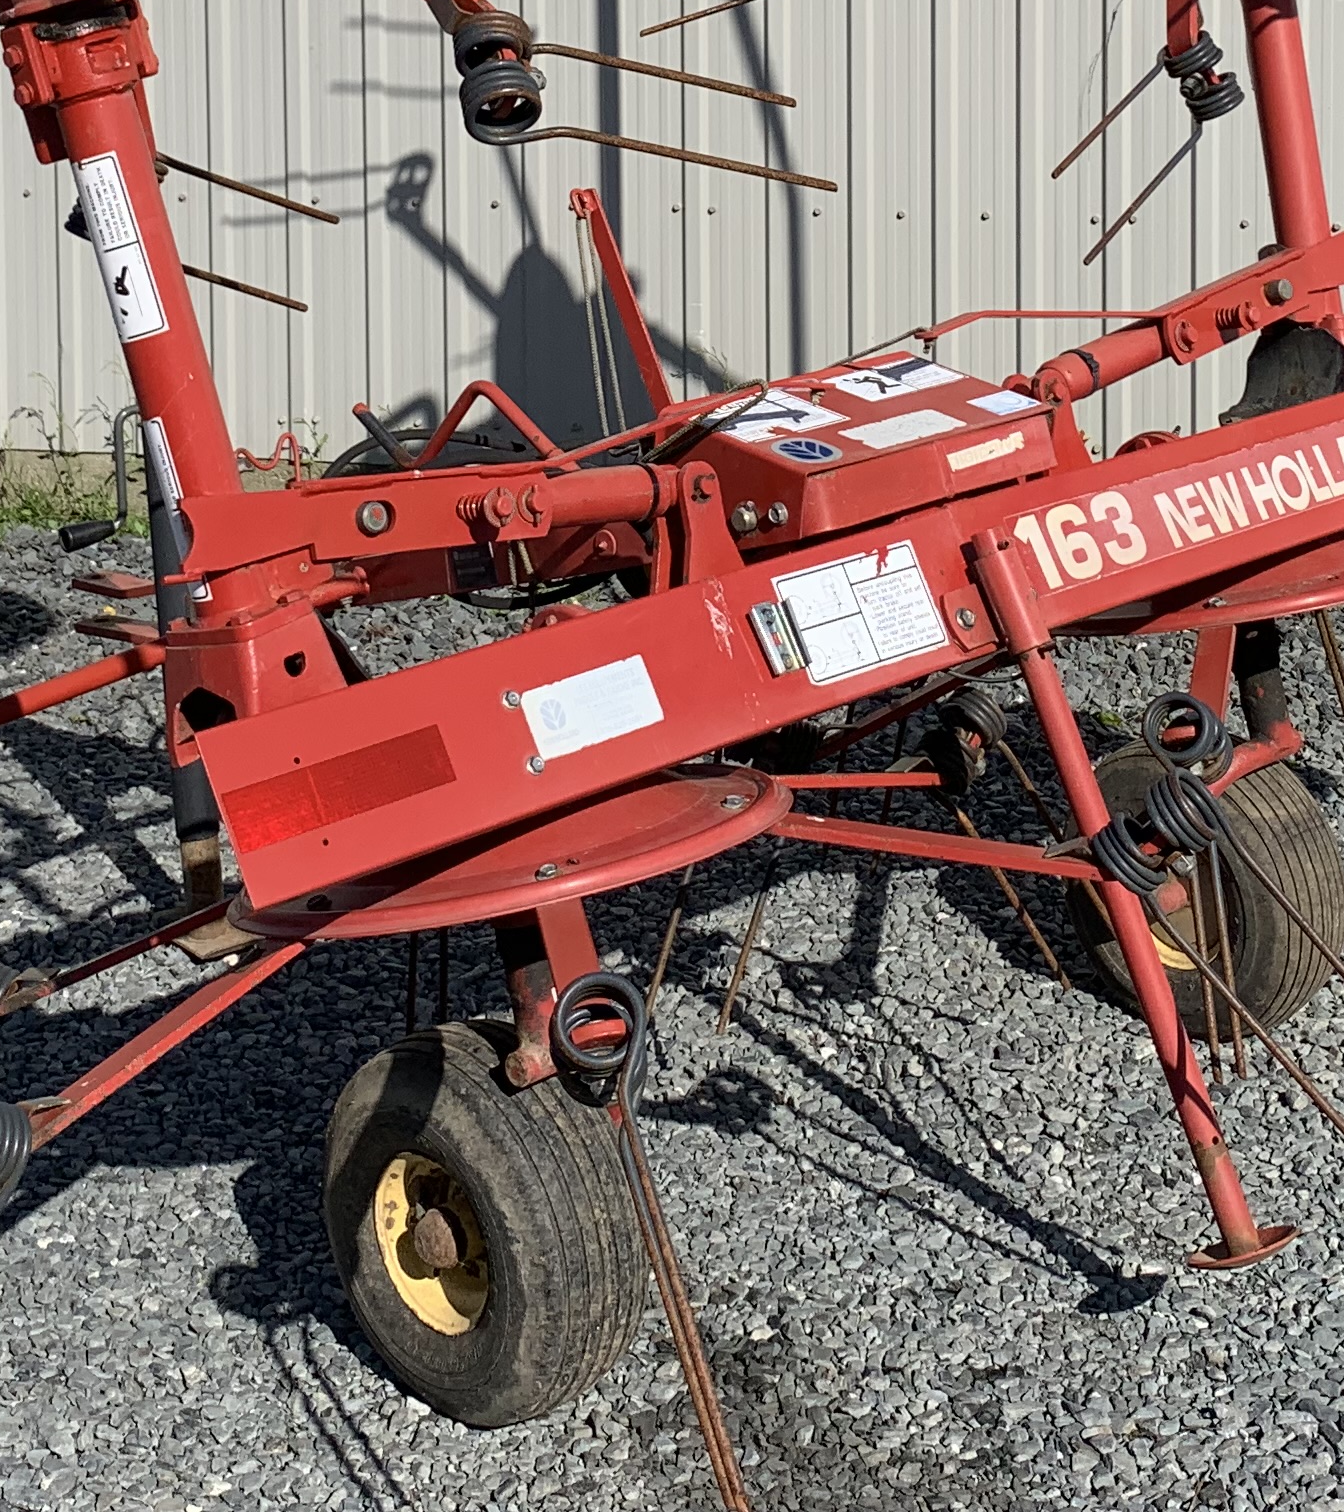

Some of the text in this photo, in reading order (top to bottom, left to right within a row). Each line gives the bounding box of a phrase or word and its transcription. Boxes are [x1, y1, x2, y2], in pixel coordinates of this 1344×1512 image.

[103, 188, 108, 196] IN
[94, 183, 115, 243] FAILURE TO COMPLY
[105, 197, 116, 219] RESULT
[113, 221, 122, 241] COULD
[1013, 490, 1147, 589] 163
[1154, 472, 1250, 549] NEW
